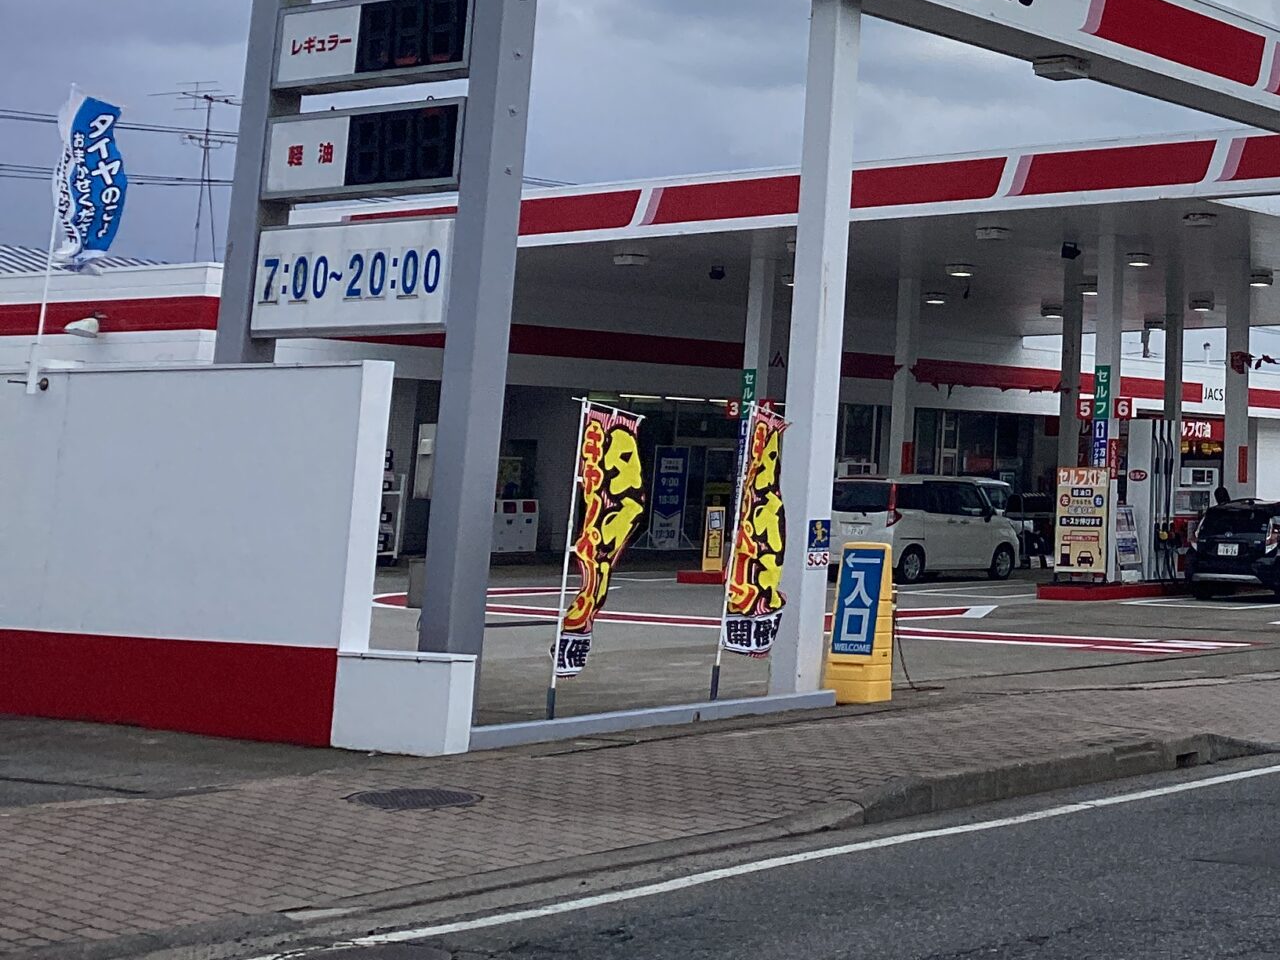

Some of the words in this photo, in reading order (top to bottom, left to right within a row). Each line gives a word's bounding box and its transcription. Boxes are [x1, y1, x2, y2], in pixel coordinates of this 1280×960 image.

[291, 34, 352, 56] レギュラー
[742, 373, 754, 413] セルフ
[1096, 369, 1107, 414] セルフ
[1204, 387, 1224, 401] JACS
[729, 402, 739, 416] 3
[1080, 401, 1091, 416] 5
[1117, 400, 1129, 416] 6
[1181, 421, 1211, 438] ルフ灯油
[1058, 469, 1107, 487] セルフ灯油
[807, 552, 829, 567] SOS
[840, 571, 873, 642] 入口
[834, 642, 871, 653] WELCOME
